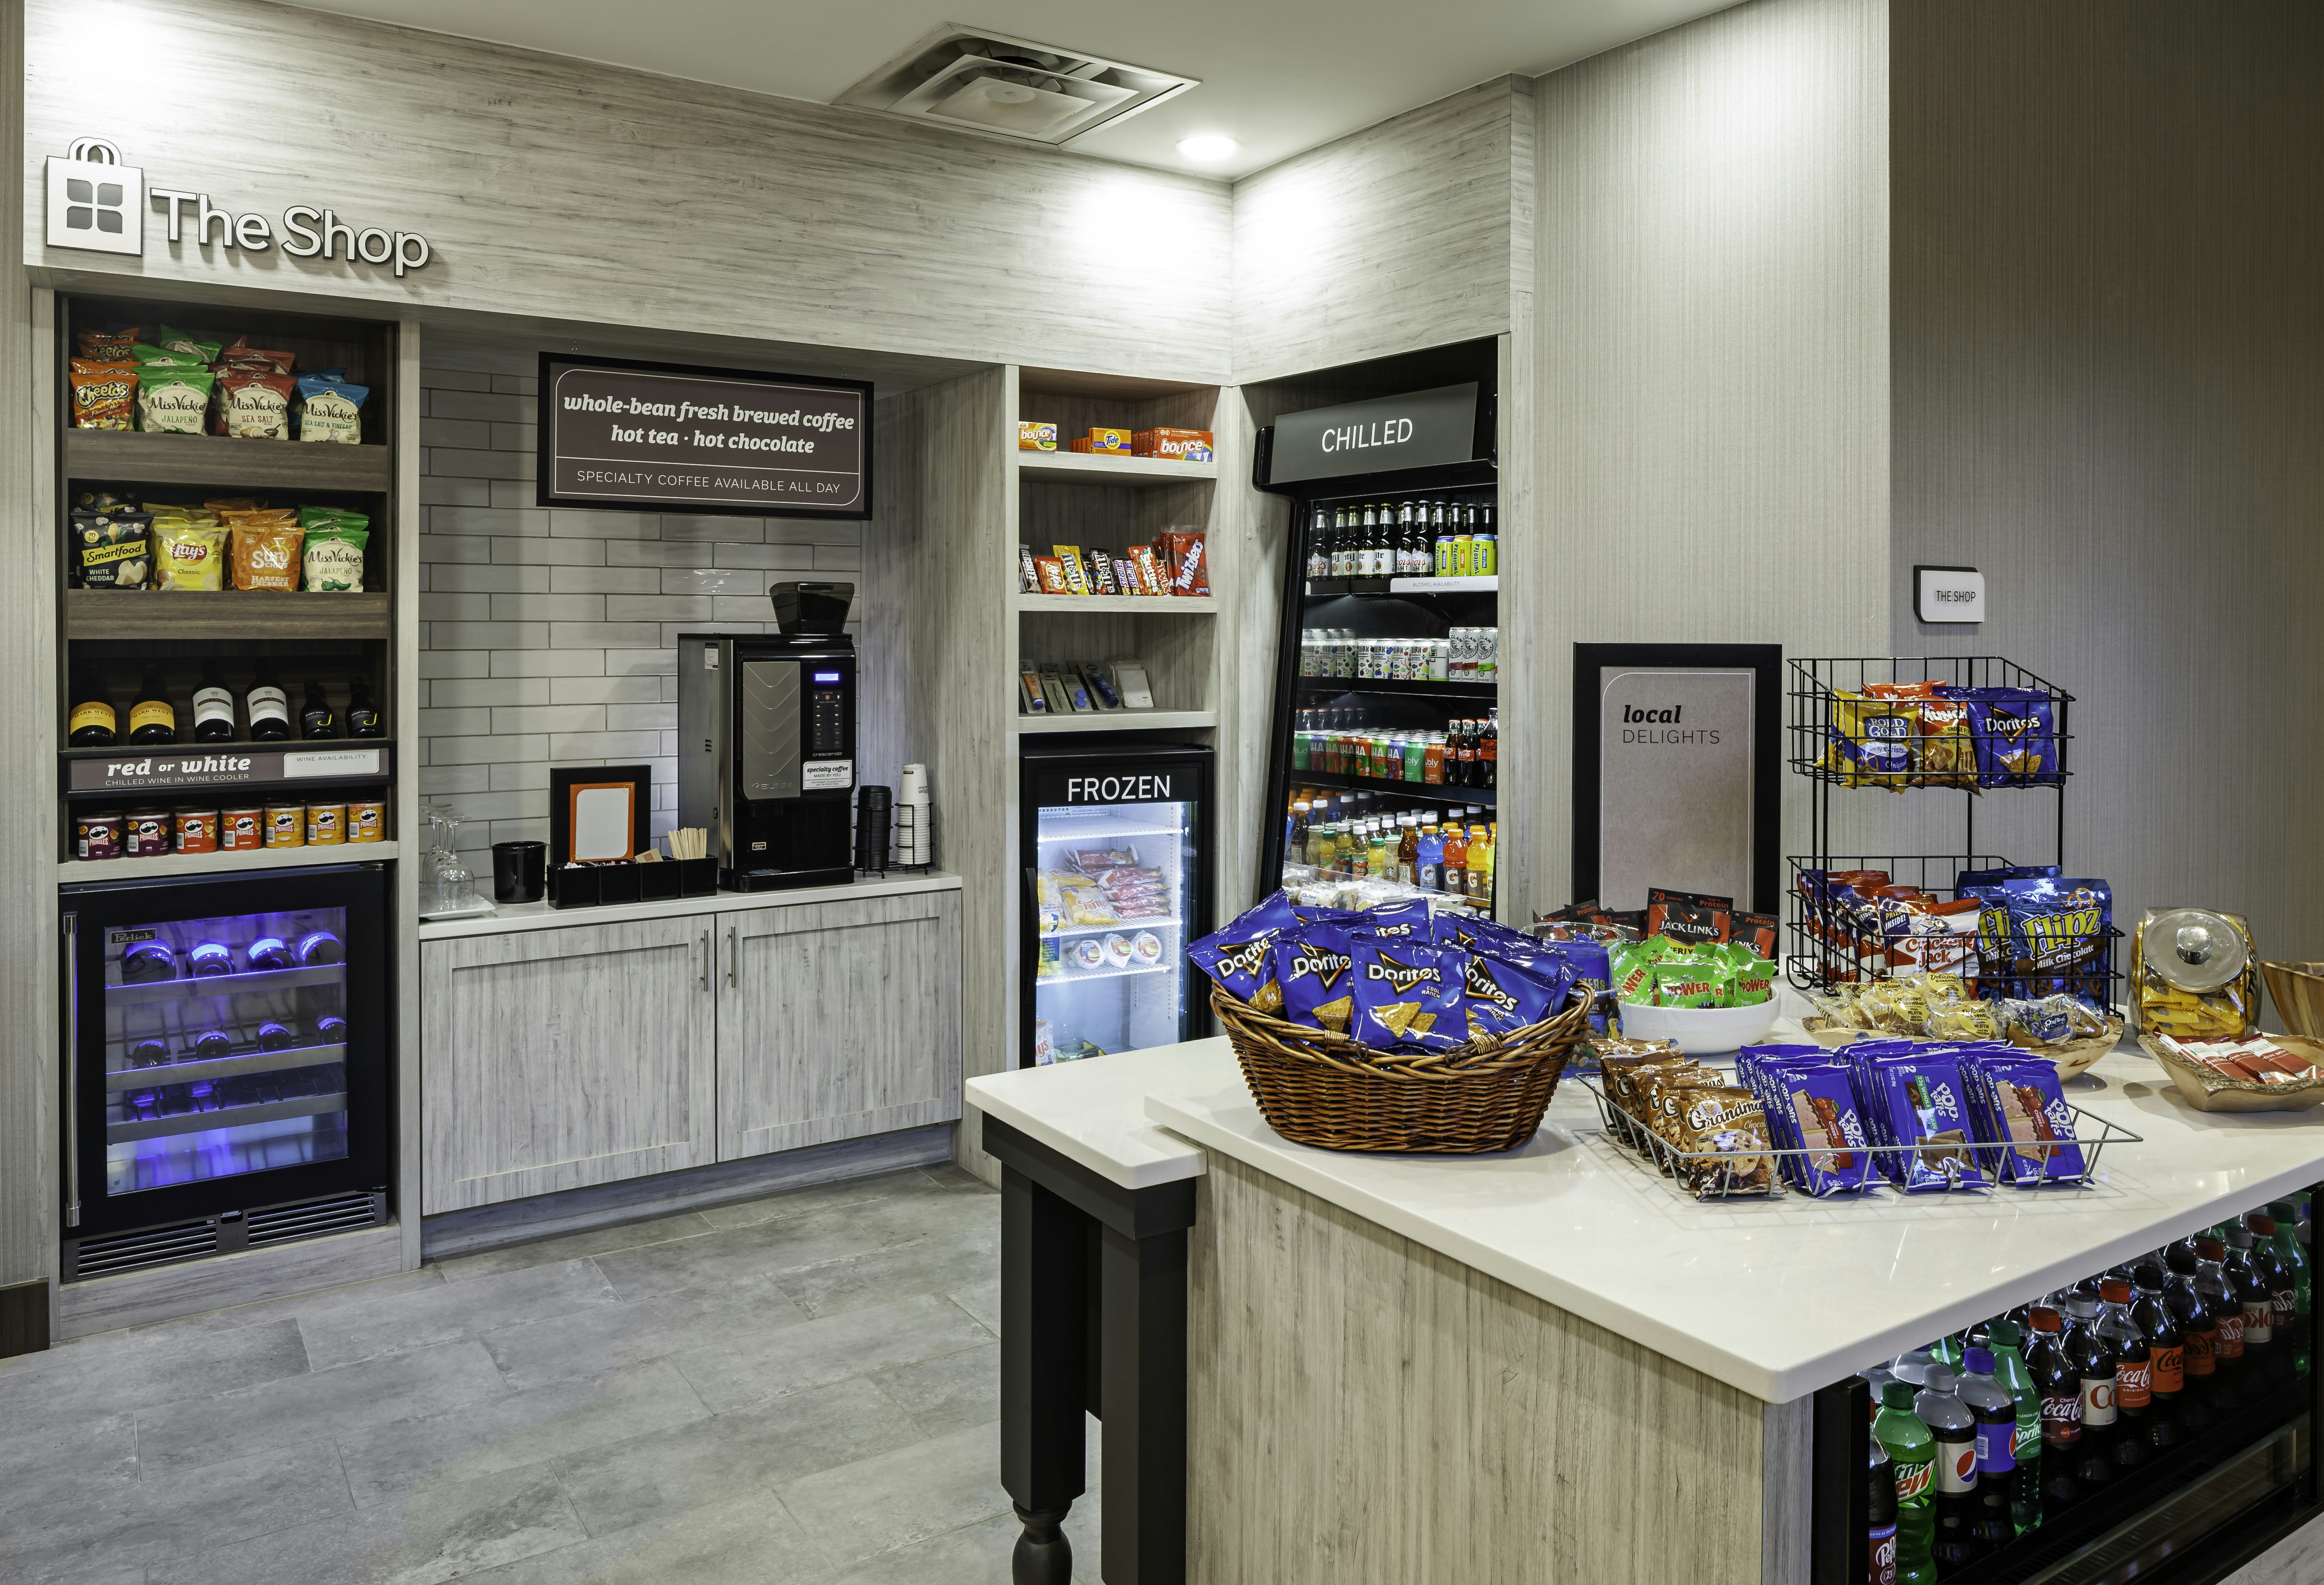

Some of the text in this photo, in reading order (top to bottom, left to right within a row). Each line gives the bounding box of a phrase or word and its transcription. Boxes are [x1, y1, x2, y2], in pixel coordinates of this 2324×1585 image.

[149, 187, 430, 278] The Shop
[77, 382, 129, 408] Cheetos
[564, 394, 854, 431] whole-bean fresh brewed coffee
[611, 425, 815, 453] hot tea hot chocolate
[1021, 429, 1051, 440] bounce
[1106, 436, 1119, 445] Tide
[1322, 418, 1413, 452] CHILLED
[1160, 438, 1203, 455] bounce
[577, 470, 840, 493] SPECIALTY COFFEE AVAILABLE ALL DAY
[86, 544, 143, 563] Smartfood
[174, 543, 205, 560] Lay's
[1140, 553, 1158, 593] Skittles
[1157, 562, 1171, 594] TWIX
[1937, 591, 1976, 602] THE SHOP
[1451, 635, 1463, 643] CLAW
[1480, 635, 1492, 643] CLAW
[74, 710, 92, 719] MARK
[133, 709, 149, 718] MARK
[1624, 704, 1682, 723] local
[1869, 718, 1905, 727] ROLD
[1986, 717, 2041, 732] Doritos
[1623, 730, 1719, 744] DELIGHTS
[1869, 726, 1906, 737] GOLD
[108, 759, 152, 776] red
[181, 755, 251, 773] white
[1886, 760, 1907, 770] Original
[1068, 775, 1170, 801] FROZEN
[318, 822, 335, 831] PRINGLES
[360, 820, 377, 828] PRINGLES
[89, 838, 109, 846] PRINGLES
[139, 833, 158, 842] PRINGLES
[1421, 866, 1434, 881] G
[1446, 870, 1459, 885] G
[1468, 872, 1477, 888] G
[1652, 891, 1665, 901] 70
[1577, 906, 1598, 916] Protein
[1700, 899, 1729, 910] Protein
[1746, 917, 1775, 926] Protein
[1885, 914, 1906, 932] INSIDE!
[1886, 910, 1902, 920] PRIZE
[114, 931, 153, 942] Perlick
[1658, 920, 1719, 937] JACK LINK'S
[2022, 909, 2101, 958] Flipz
[1906, 937, 1968, 954] Cracker
[1919, 950, 1952, 967] Jack
[2037, 944, 2094, 969] Milk Chocolate
[1293, 955, 1352, 977] Dorito
[1369, 964, 1441, 984] Doritos
[1426, 986, 1440, 994] COOL
[1667, 981, 1710, 998] POWER
[1741, 978, 1770, 993] POWER
[1421, 990, 1441, 999] RANCH
[1920, 1086, 1931, 1108] WHOLE
[1930, 1089, 1946, 1118] tarts
[2033, 1109, 2043, 1128] CHERRY
[2044, 1106, 2062, 1137] tarts
[1828, 1120, 1838, 1140] CHERRY
[1838, 1118, 1857, 1148] tarts
[1886, 1571, 1893, 1580] 23
